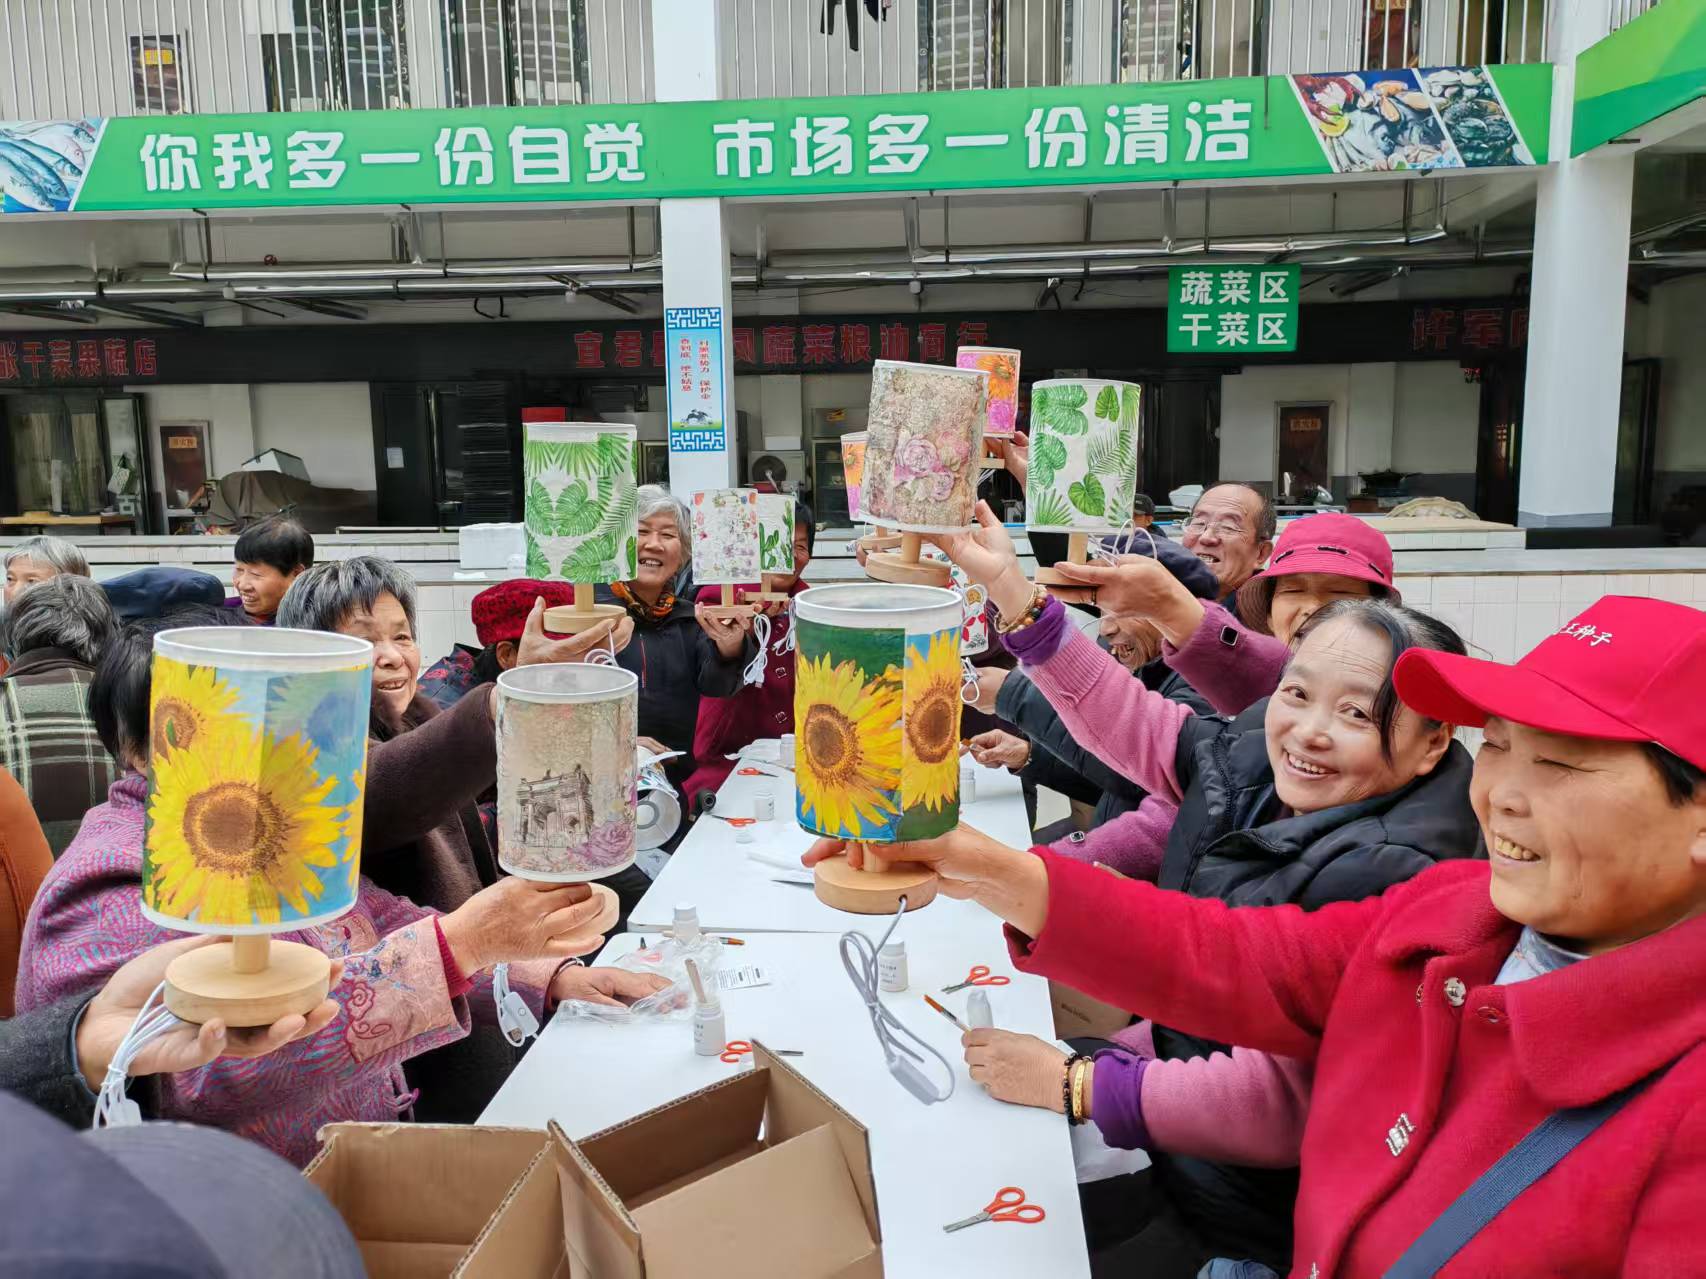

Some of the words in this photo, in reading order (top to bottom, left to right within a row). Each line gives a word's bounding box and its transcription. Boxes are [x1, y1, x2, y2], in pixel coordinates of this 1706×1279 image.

[140, 123, 645, 192] 你我多一份自觉
[714, 99, 1252, 177] 市场多一份清洁
[1180, 272, 1289, 305] 蔬菜区
[1179, 313, 1288, 346] 干菜区
